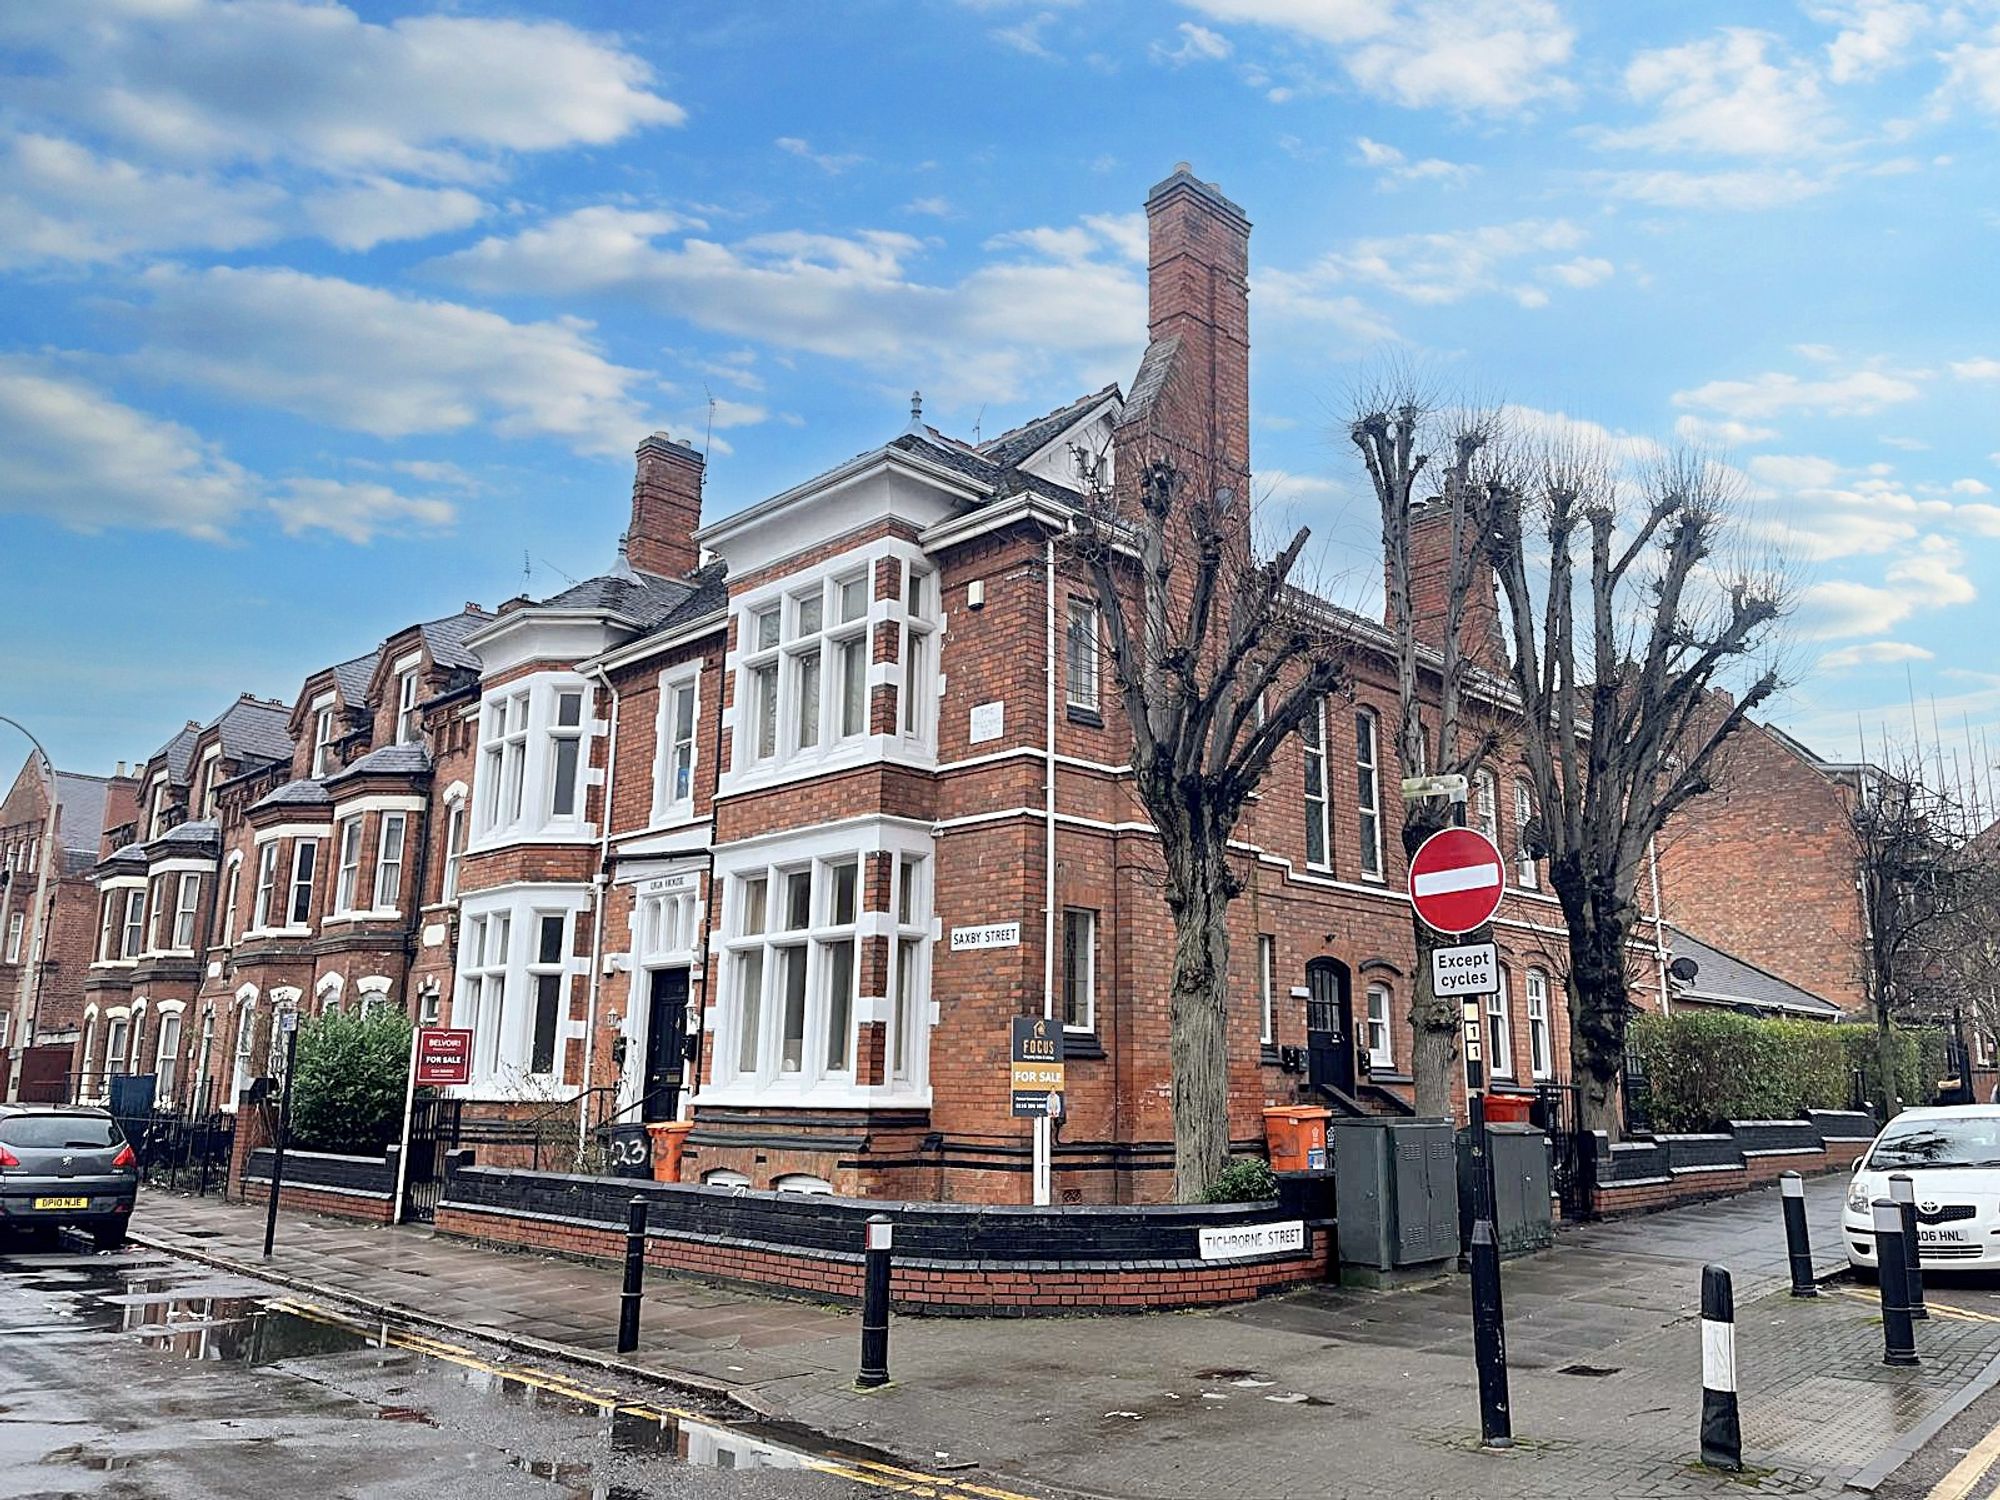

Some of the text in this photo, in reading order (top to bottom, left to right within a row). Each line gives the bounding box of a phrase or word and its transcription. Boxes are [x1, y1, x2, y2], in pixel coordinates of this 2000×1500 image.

[954, 928, 1016, 945] SAXBY STREET
[1438, 951, 1489, 988] Except cycles
[1470, 1026, 1476, 1037] 1
[1023, 1040, 1054, 1054] FOCUS
[1472, 1046, 1479, 1057] 1
[426, 1056, 461, 1064] FOR SALE
[1015, 1071, 1062, 1083] FOR SALE
[614, 1139, 646, 1165] 23
[64, 1197, 81, 1207] NJE
[1204, 1228, 1300, 1251] TICHBORNE STREET
[1939, 1230, 1964, 1242] HNL
